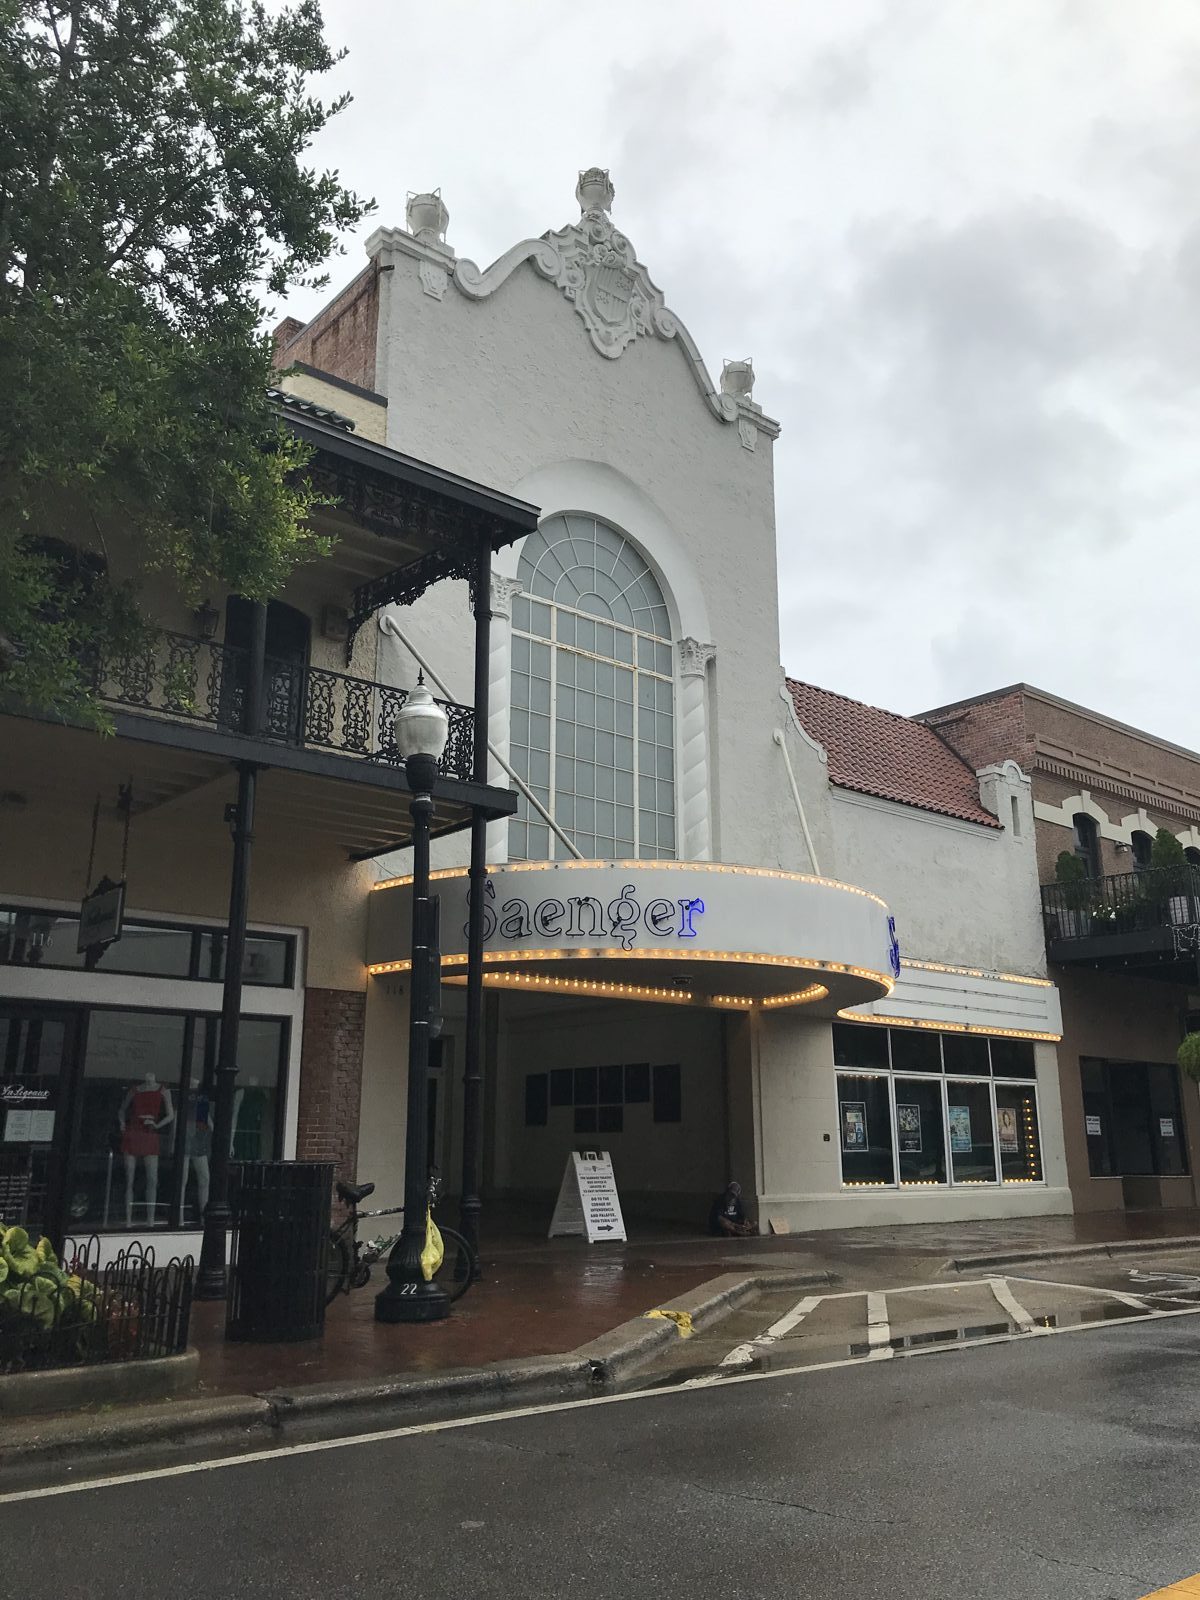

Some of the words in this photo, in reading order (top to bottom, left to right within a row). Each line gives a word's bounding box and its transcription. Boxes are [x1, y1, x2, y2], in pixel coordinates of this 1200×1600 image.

[463, 879, 705, 952] Saenger
[32, 932, 54, 947] 116
[400, 1283, 417, 1295] 22
